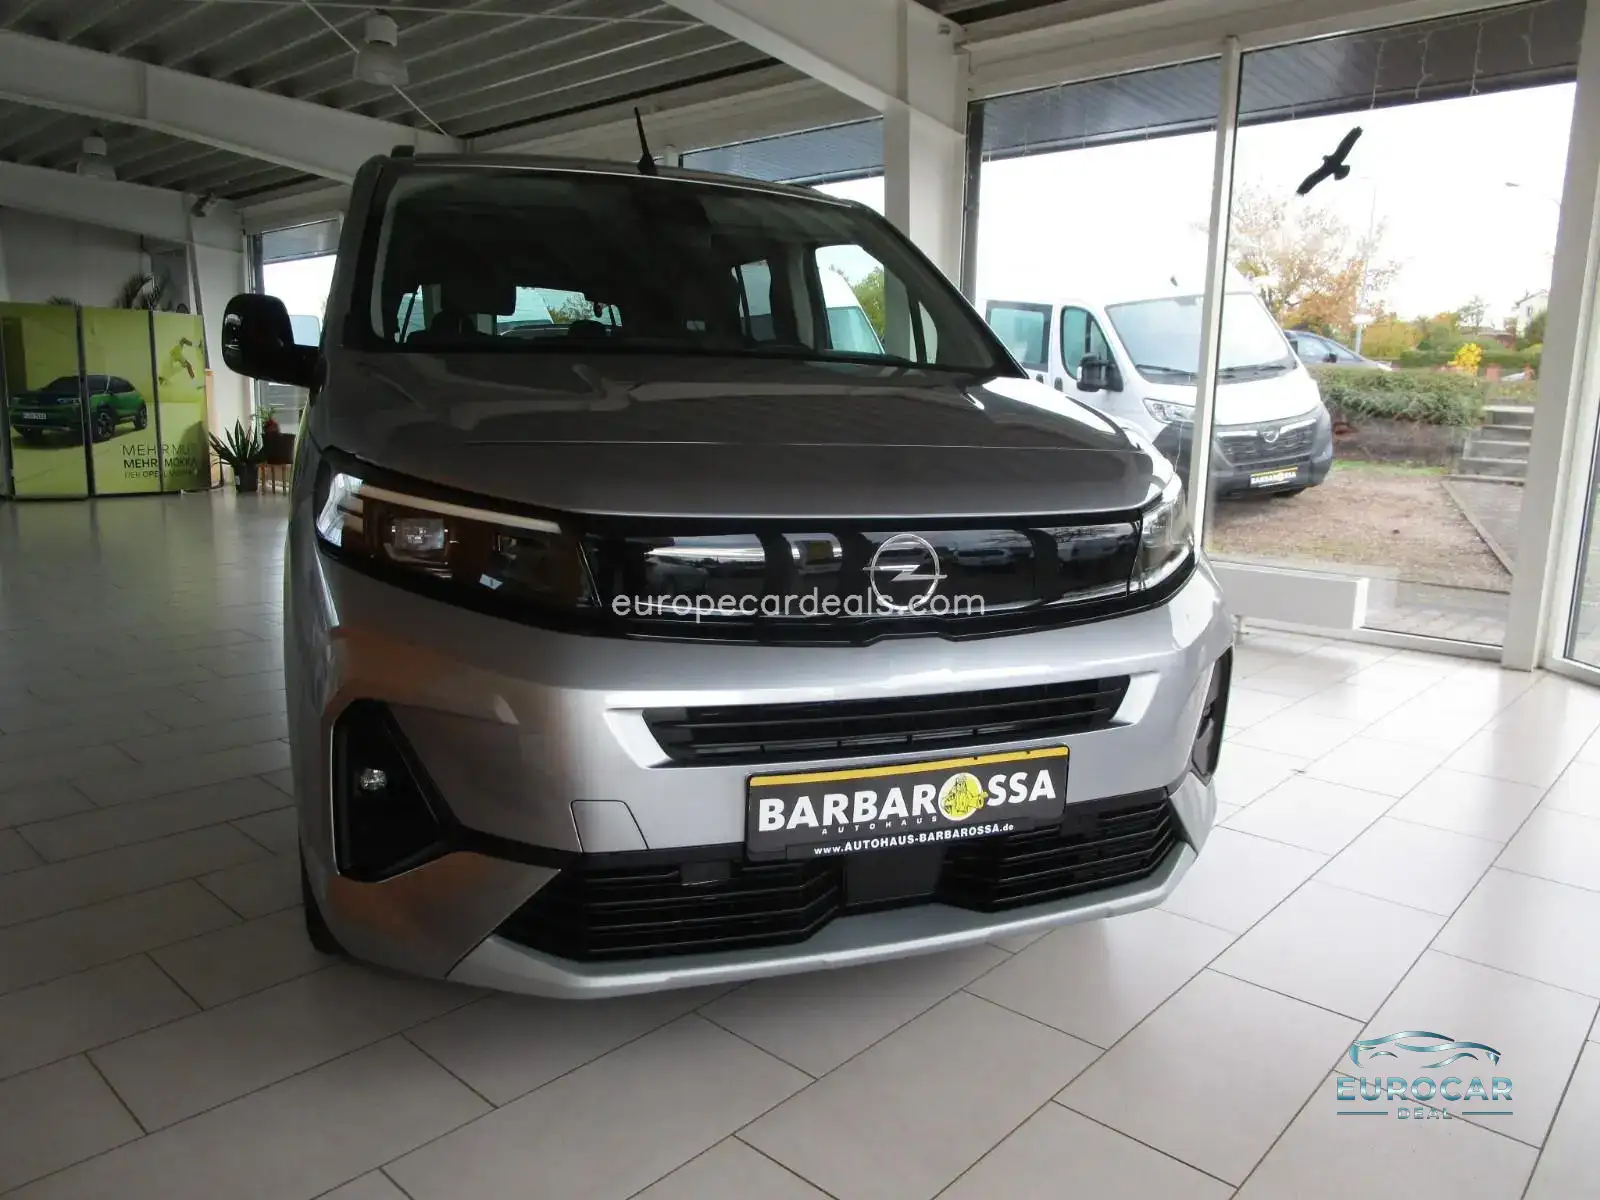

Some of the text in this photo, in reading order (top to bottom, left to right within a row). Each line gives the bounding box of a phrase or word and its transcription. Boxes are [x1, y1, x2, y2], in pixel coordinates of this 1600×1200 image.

[122, 443, 169, 456] MEHR
[123, 458, 158, 469] MEHR
[758, 769, 1056, 832] BARBAROSSA
[821, 816, 937, 835] AUTOHAUS
[814, 823, 1014, 855] www.AUTOHAUS-BARBAROSSA.de
